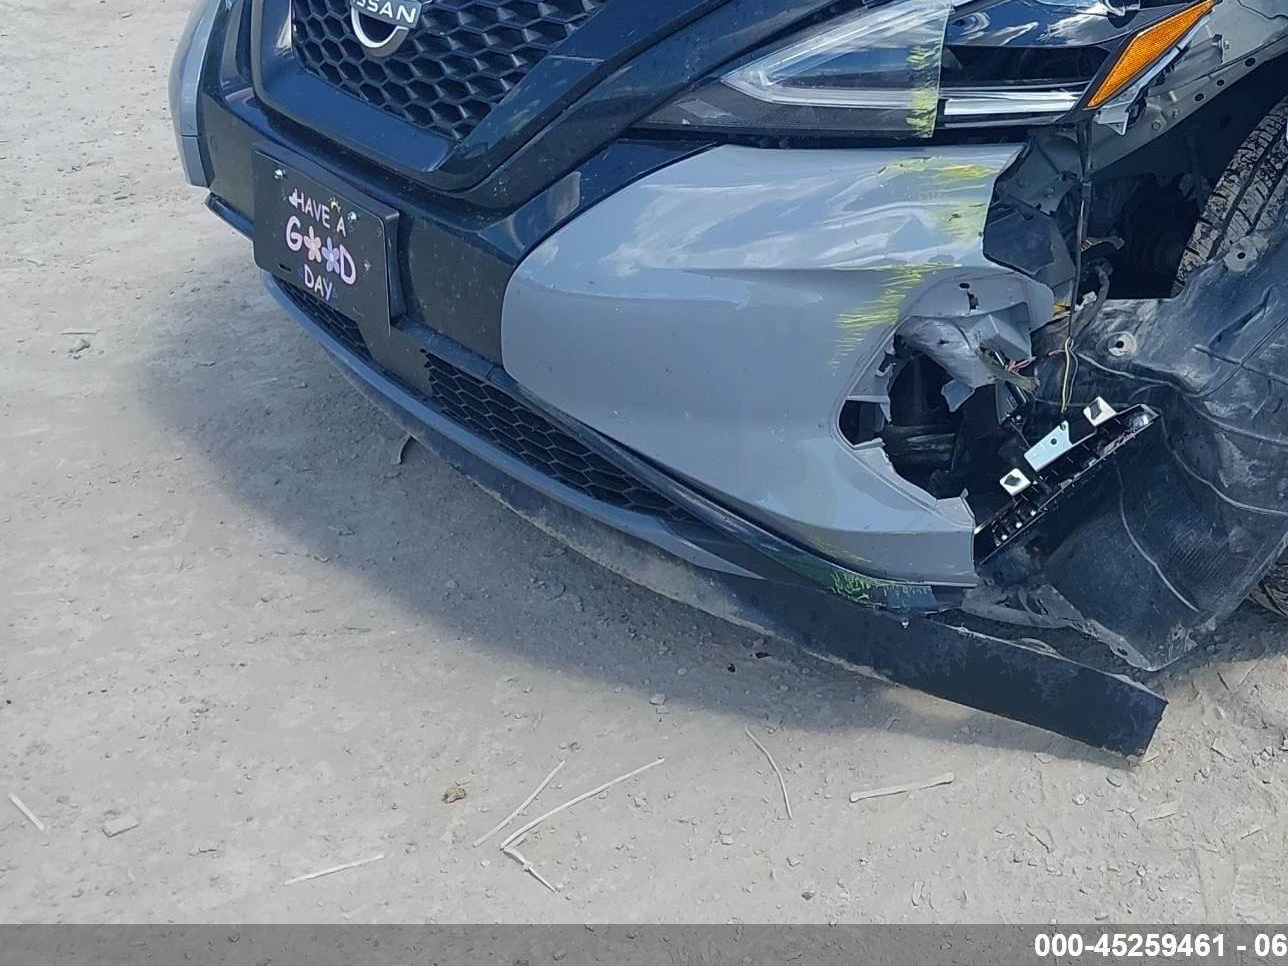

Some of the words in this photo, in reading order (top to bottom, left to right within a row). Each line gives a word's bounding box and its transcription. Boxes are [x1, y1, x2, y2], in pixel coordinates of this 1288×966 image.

[294, 189, 331, 229] HAVE
[336, 216, 346, 237] A
[304, 263, 333, 301] DAY
